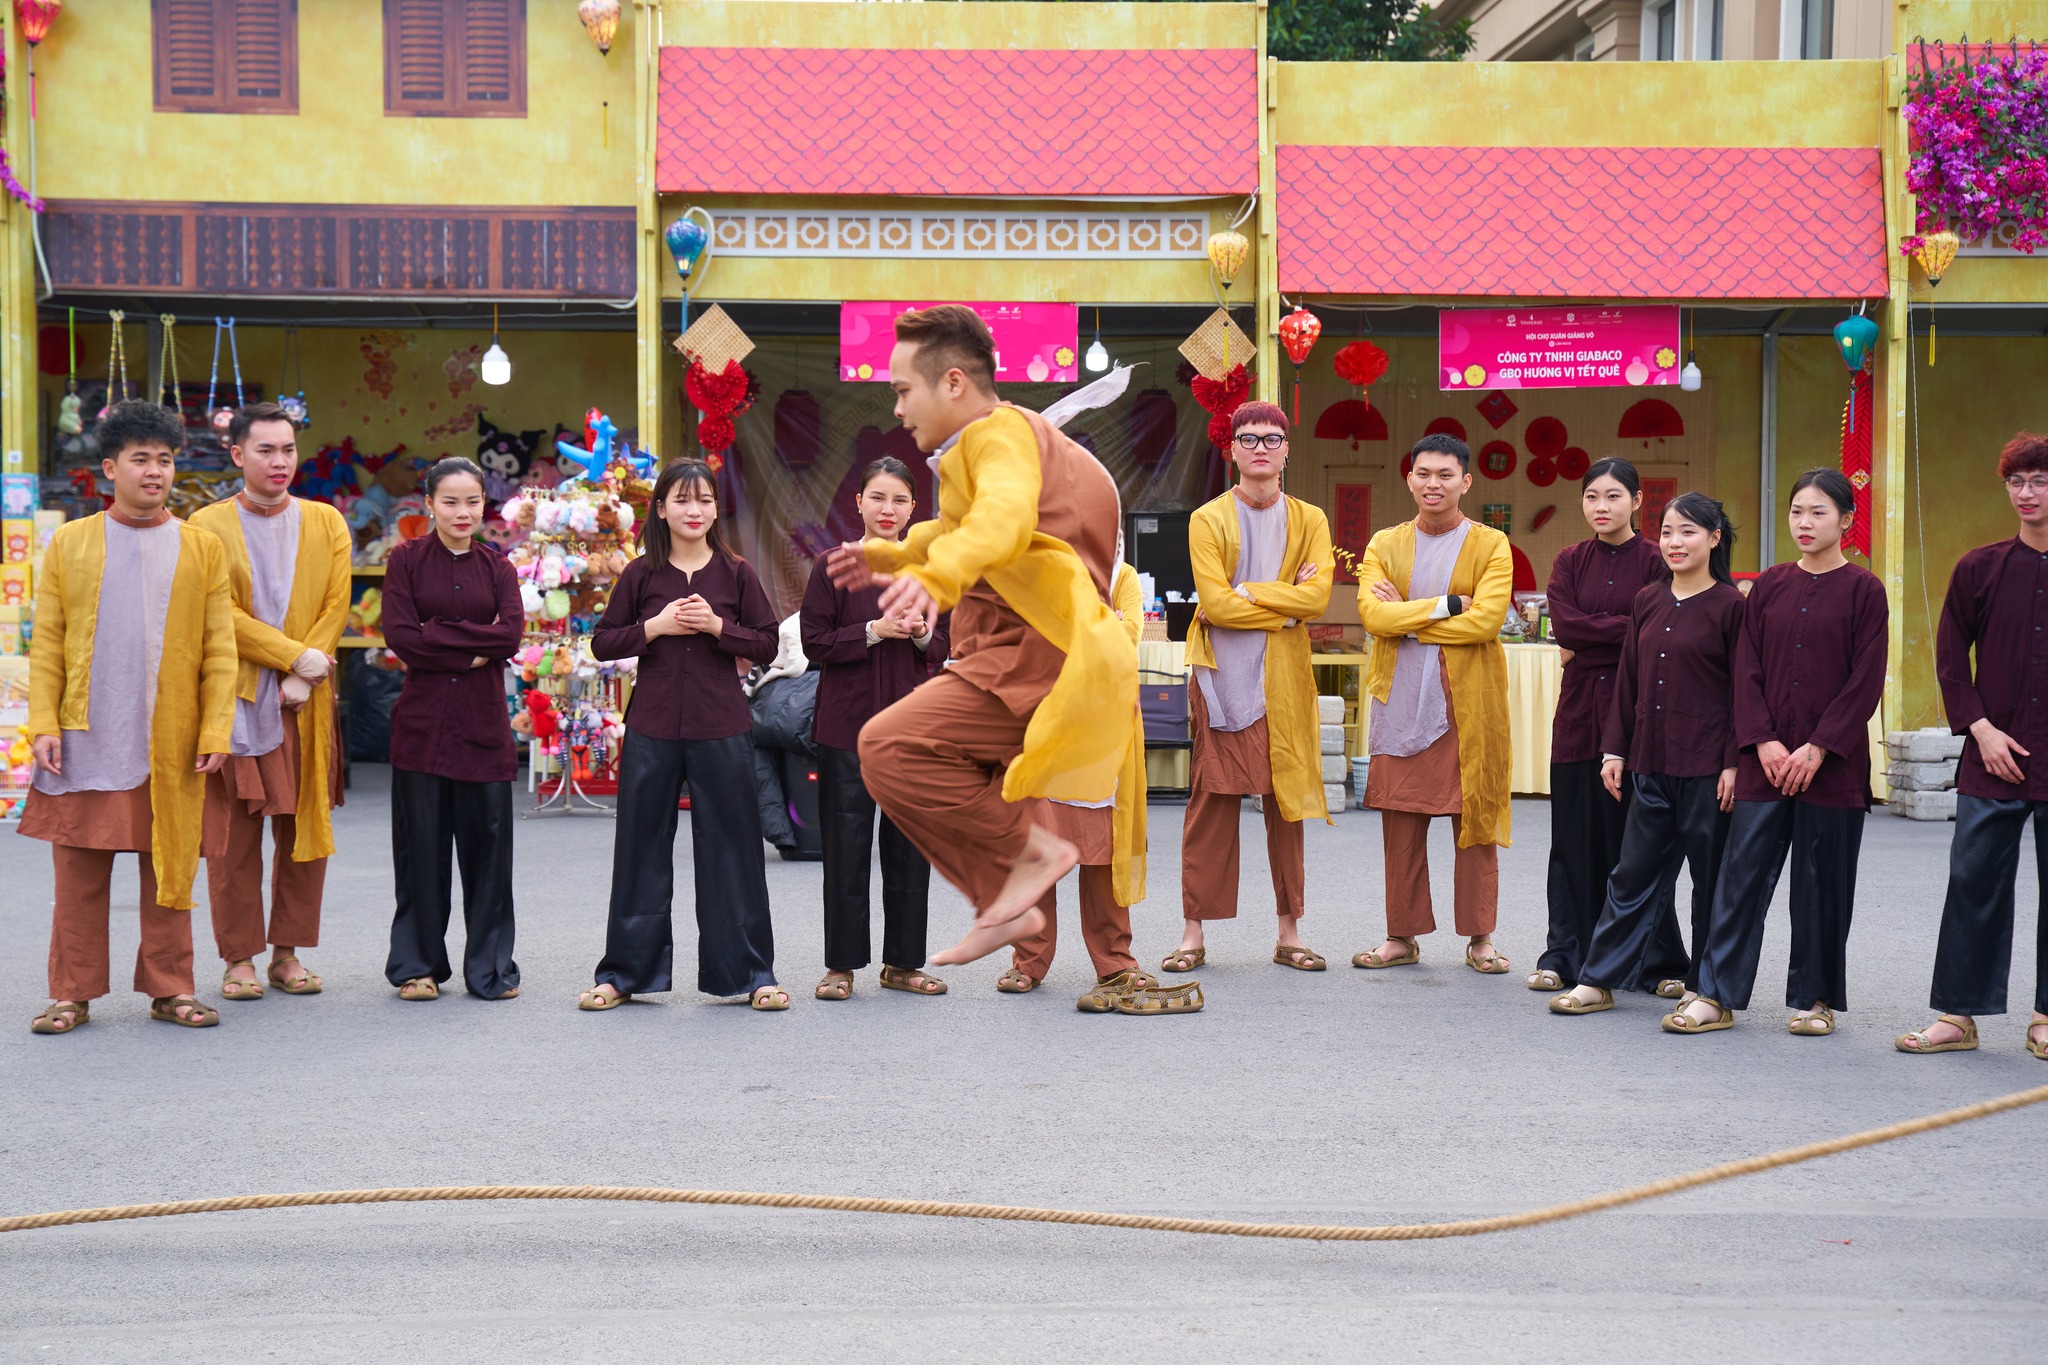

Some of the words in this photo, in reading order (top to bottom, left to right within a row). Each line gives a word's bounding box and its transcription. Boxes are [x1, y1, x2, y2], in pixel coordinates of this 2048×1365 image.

[1537, 333, 1549, 341] CHỢ
[1497, 351, 1527, 363] CÔNG
[1529, 352, 1543, 363] TY
[1544, 352, 1574, 363] TNHH
[1576, 350, 1623, 361] GIABACO
[1499, 368, 1522, 379] GBO
[1524, 366, 1562, 378] HƯƠNG
[1564, 366, 1575, 379] VỊ
[1577, 364, 1597, 377] TẾT
[1598, 364, 1620, 378] QUÊ
